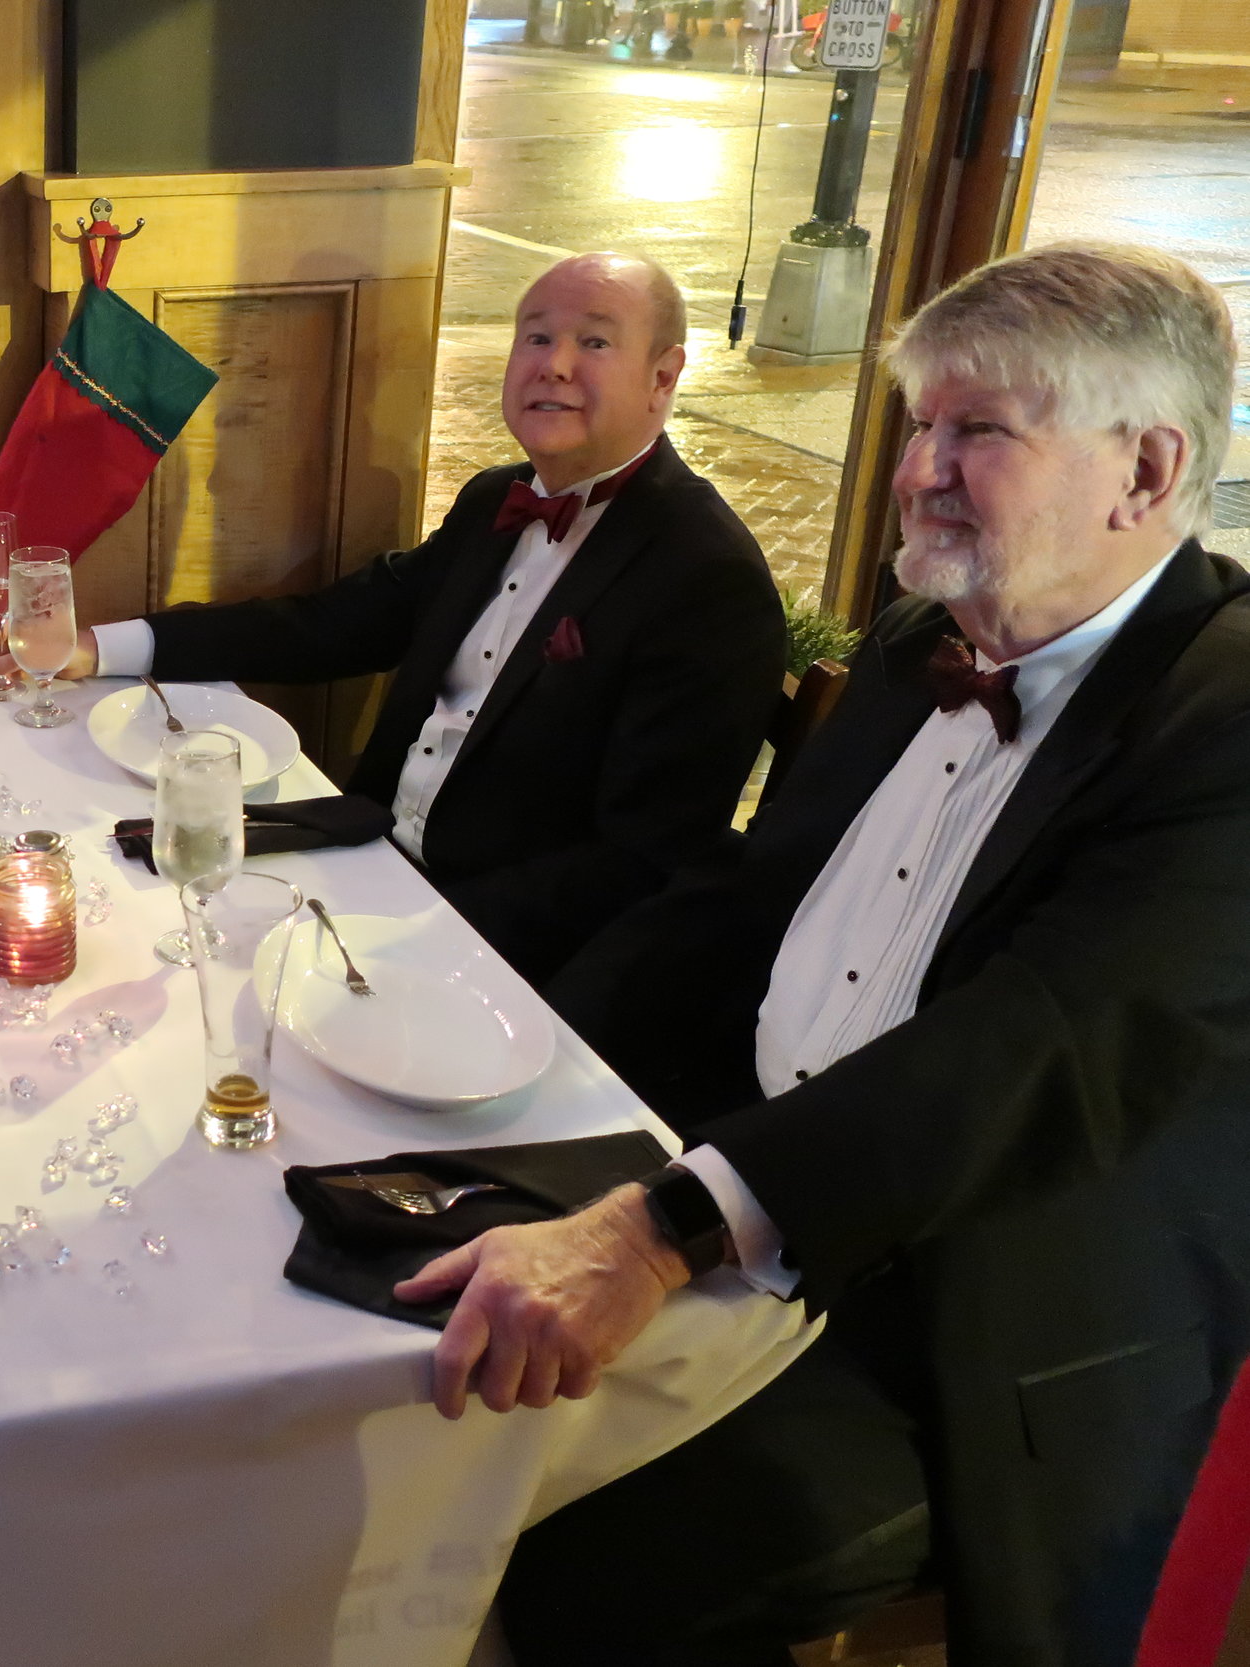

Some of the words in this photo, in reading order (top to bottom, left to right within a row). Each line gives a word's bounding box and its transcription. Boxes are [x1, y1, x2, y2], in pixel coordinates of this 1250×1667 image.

[833, 0, 886, 15] BUTTON
[848, 21, 864, 36] TO
[828, 41, 875, 58] CROSS
